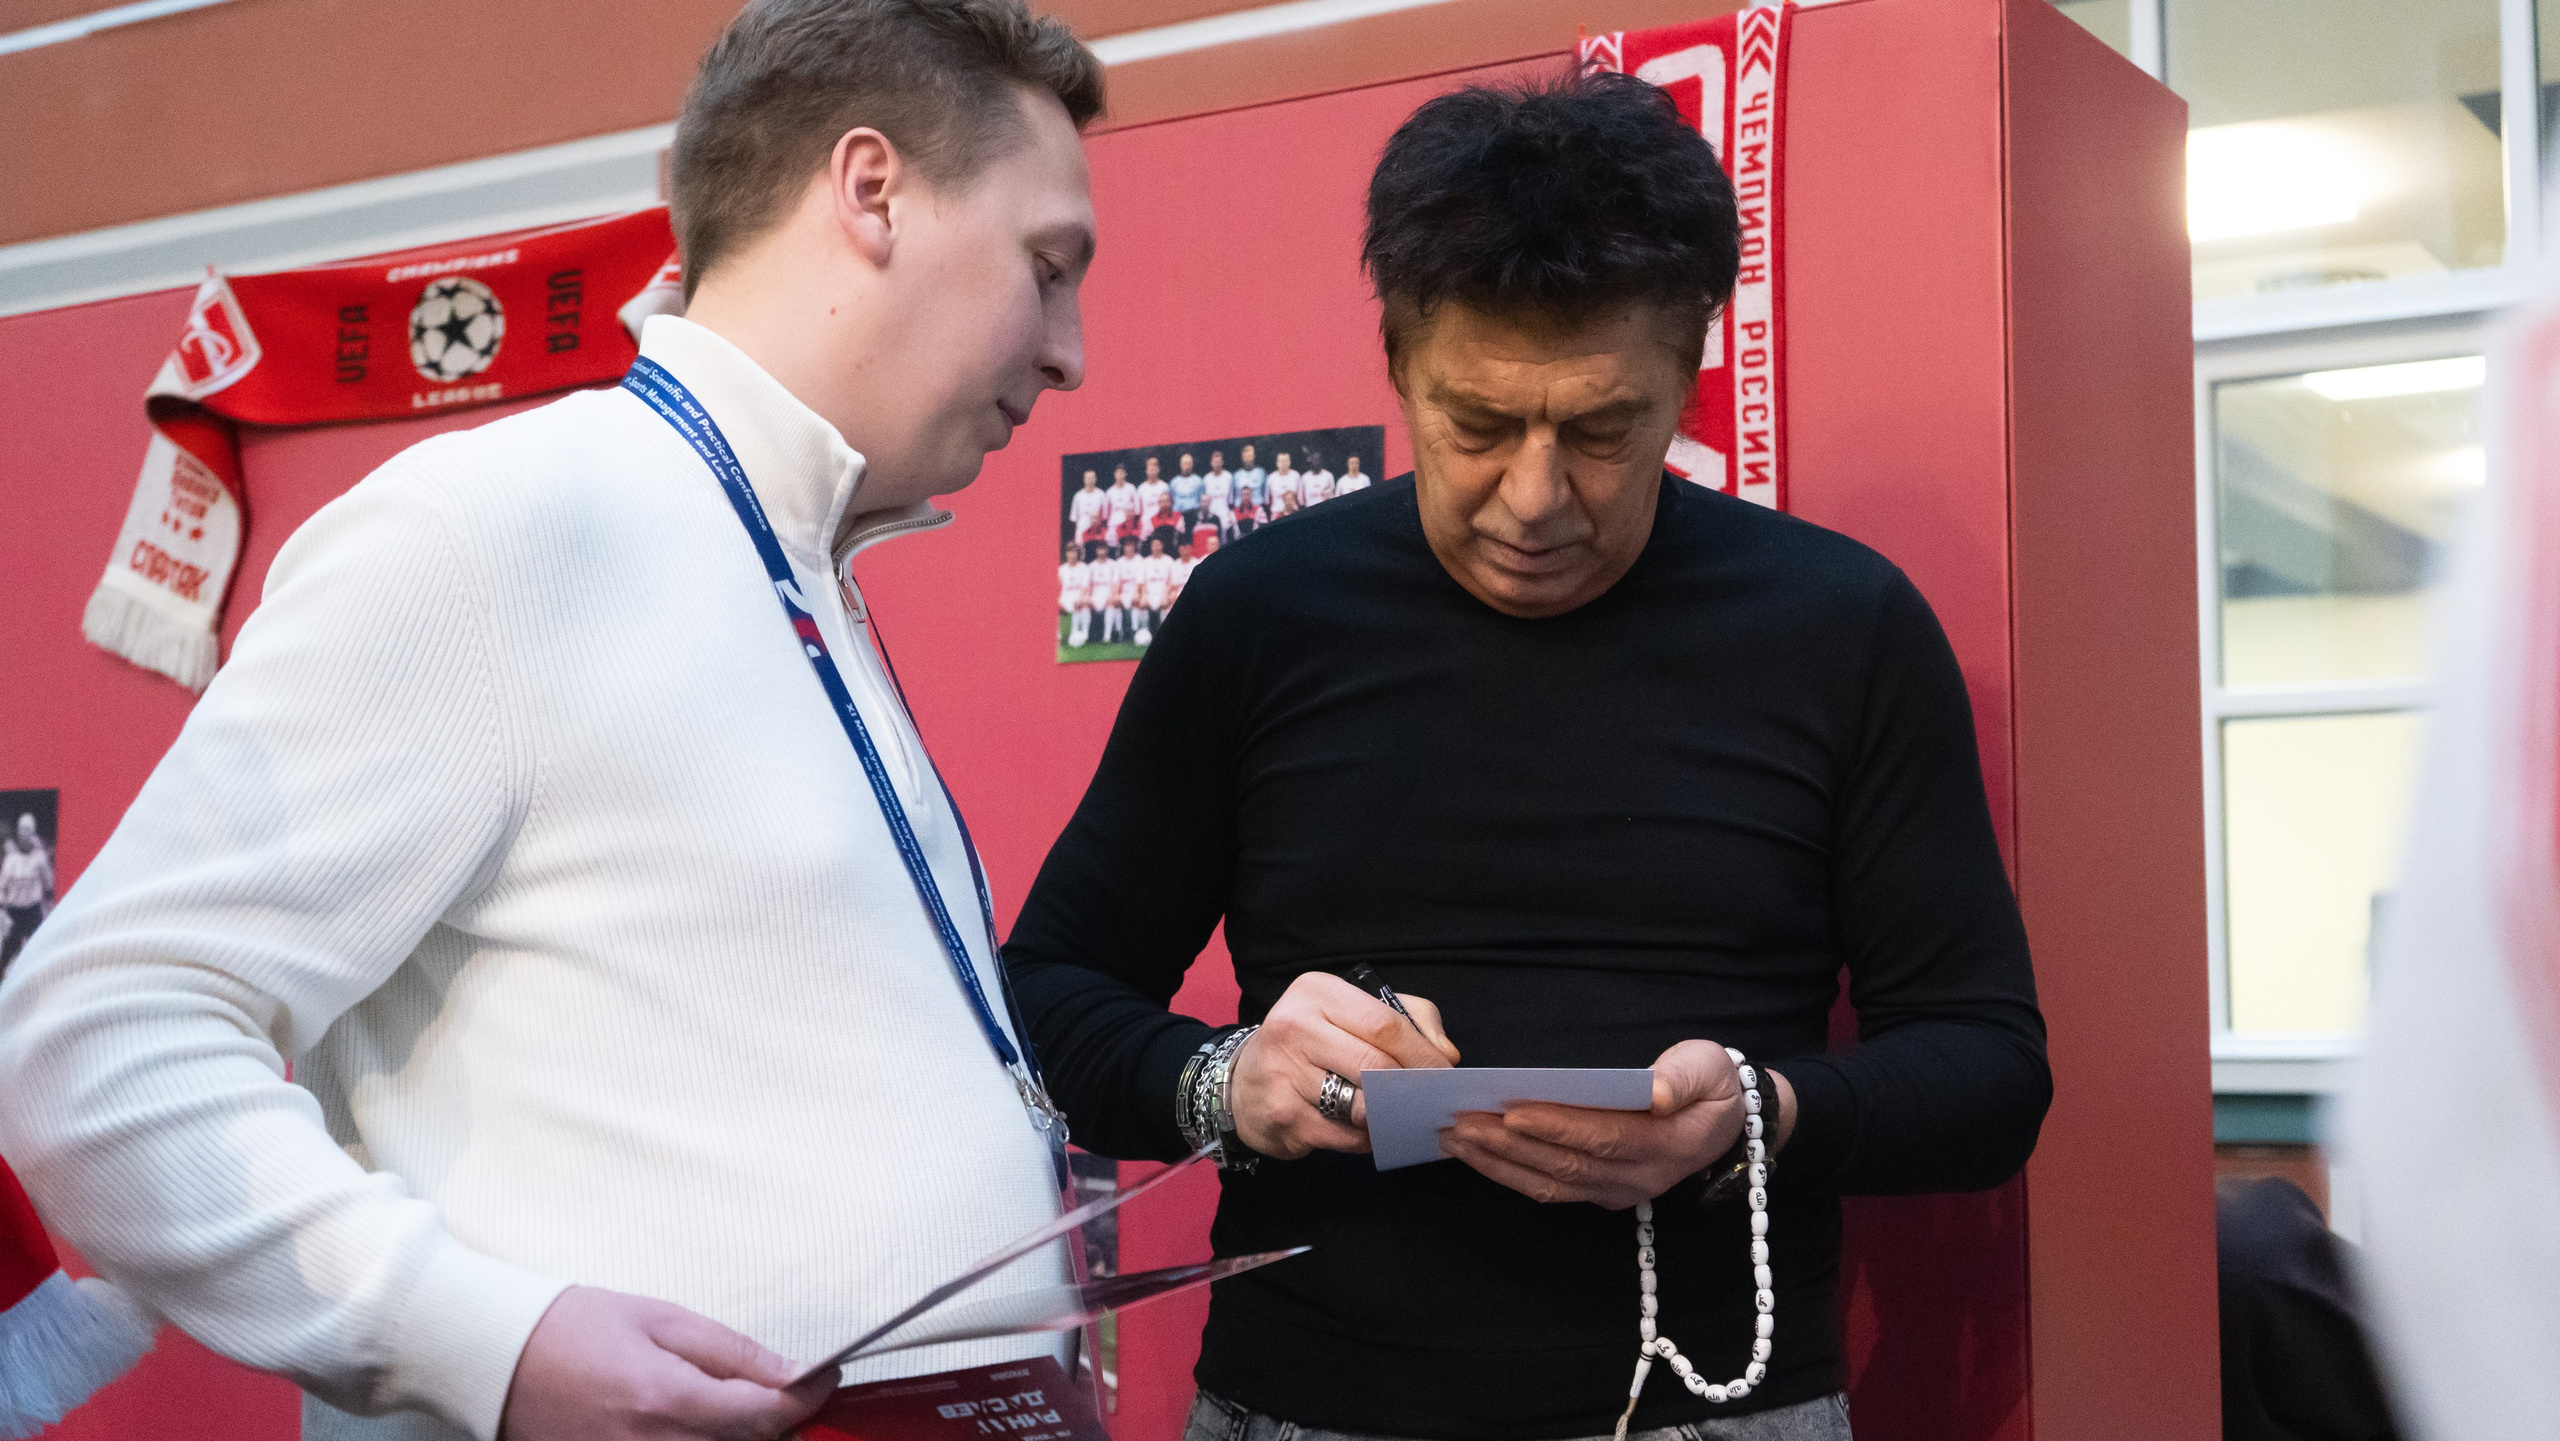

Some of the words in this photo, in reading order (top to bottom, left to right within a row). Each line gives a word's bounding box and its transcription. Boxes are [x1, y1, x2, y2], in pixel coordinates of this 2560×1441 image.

[1739, 90, 1768, 286] ЧЕМПИОН
[336, 304, 369, 385] UEFA
[546, 269, 583, 355] UEFA
[629, 376, 647, 394] Sports
[645, 387, 699, 439] Management
[695, 438, 715, 459] and
[711, 458, 729, 482] Law
[648, 368, 684, 403] Scientific
[681, 400, 704, 420] and
[697, 417, 735, 465] Practical
[729, 465, 768, 532] Conference
[1740, 319, 1770, 487] РОССИИ
[854, 719, 902, 818] Международная
[863, 756, 873, 772] по
[871, 774, 909, 851] спортивному
